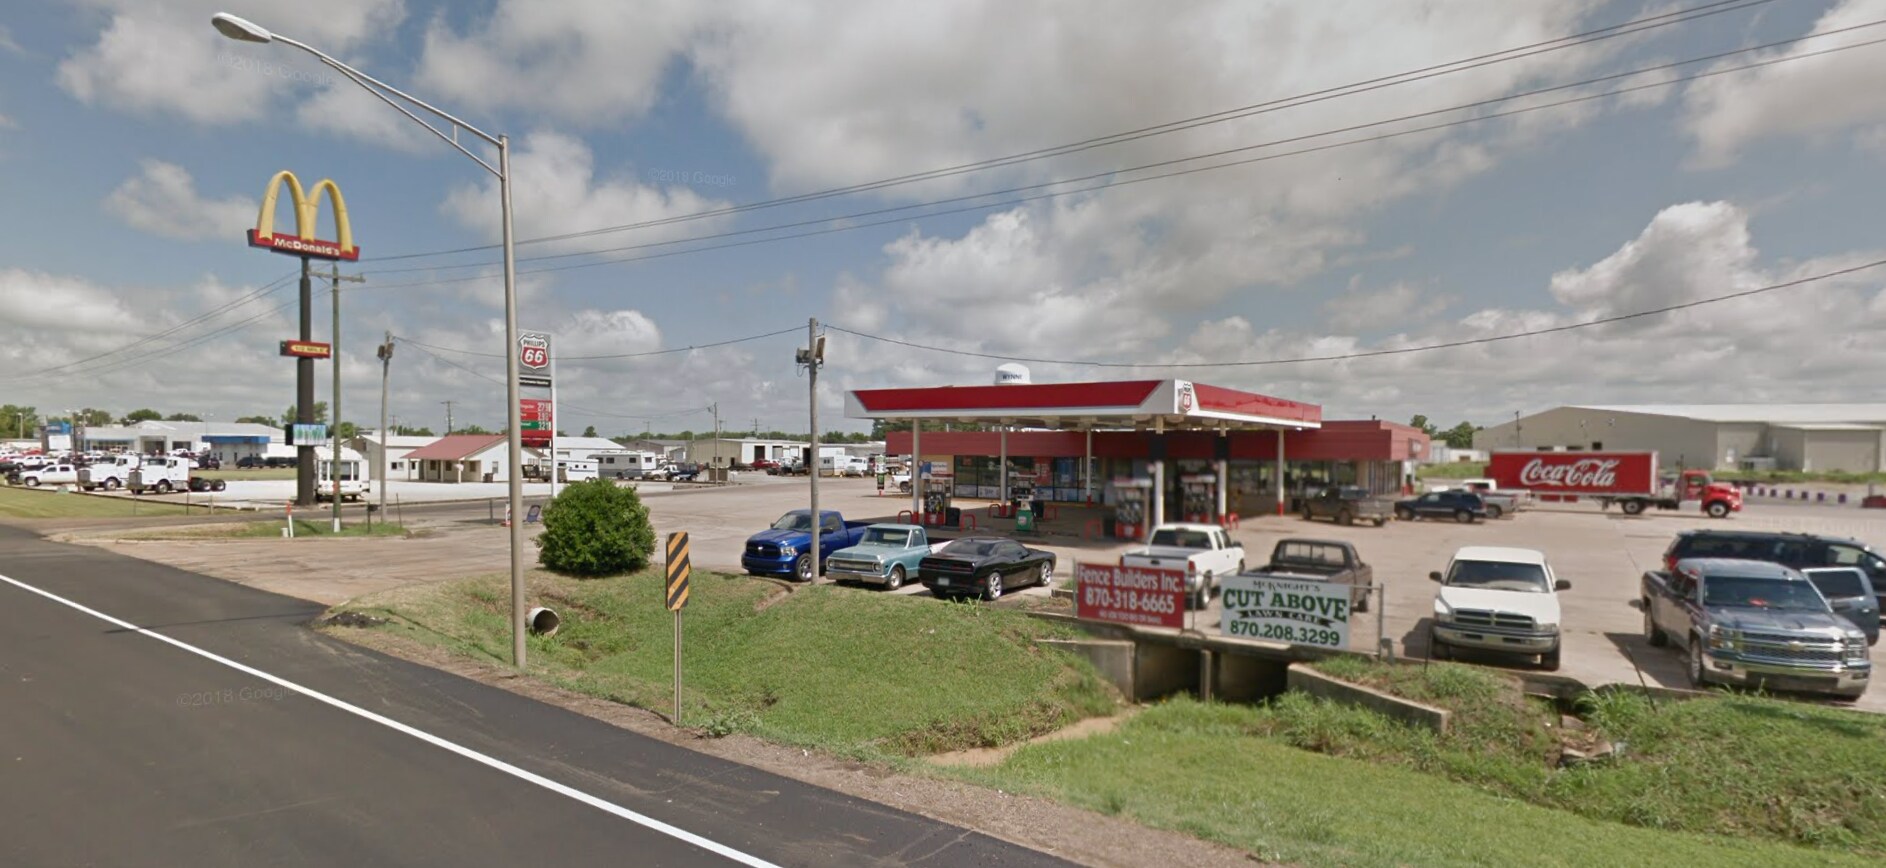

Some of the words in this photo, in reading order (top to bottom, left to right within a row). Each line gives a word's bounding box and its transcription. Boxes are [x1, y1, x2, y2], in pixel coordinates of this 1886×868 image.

[274, 238, 341, 257] McDonald's
[524, 349, 544, 363] 66
[1079, 565, 1111, 586] Fence
[1113, 568, 1158, 590] Builders
[1161, 572, 1183, 592] Inc.
[1085, 586, 1175, 615] 870-318-6665
[1222, 587, 1265, 610] CUT
[1270, 592, 1347, 624] ABOVE
[1247, 609, 1283, 619] LAWN
[1288, 611, 1320, 624] CARE
[1230, 619, 1340, 647] 870.208.3299
